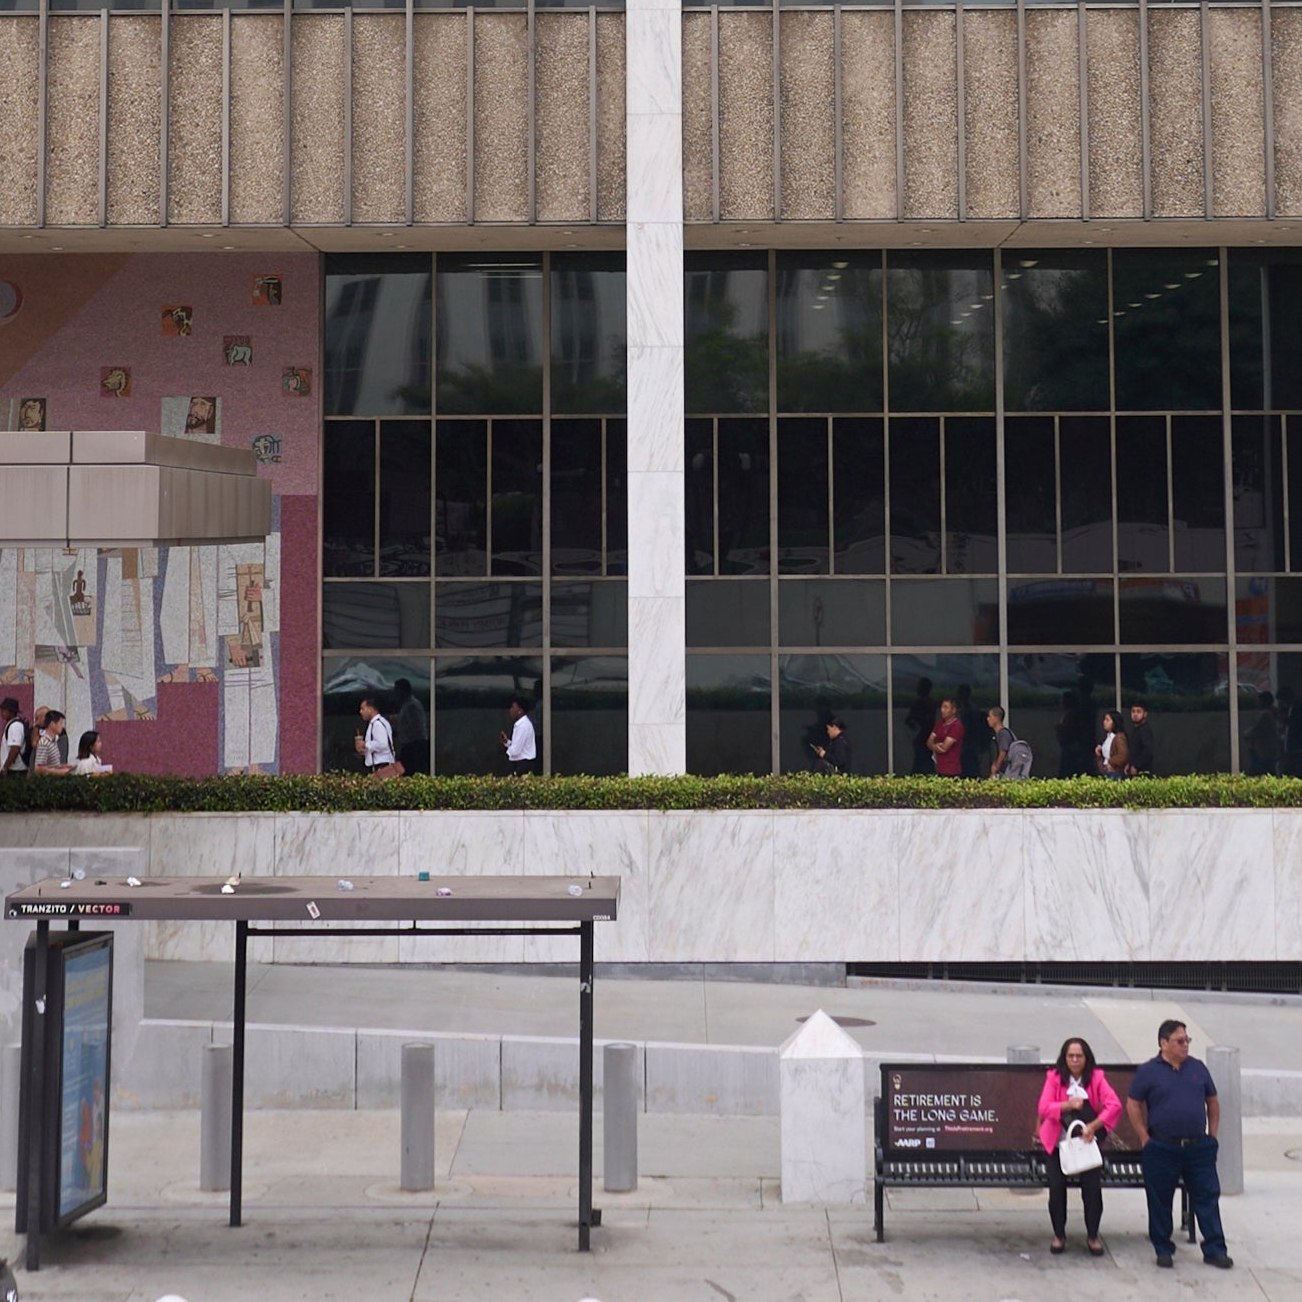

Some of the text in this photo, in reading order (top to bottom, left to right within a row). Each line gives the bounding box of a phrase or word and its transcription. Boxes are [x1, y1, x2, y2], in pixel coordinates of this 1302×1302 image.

[21, 904, 67, 914] TRANZITO
[78, 904, 121, 914] VECTOR
[893, 1094, 982, 1107] RETIREMENT IS
[893, 1109, 999, 1122] THE LONG GAME.
[894, 1138, 921, 1148] AARP
